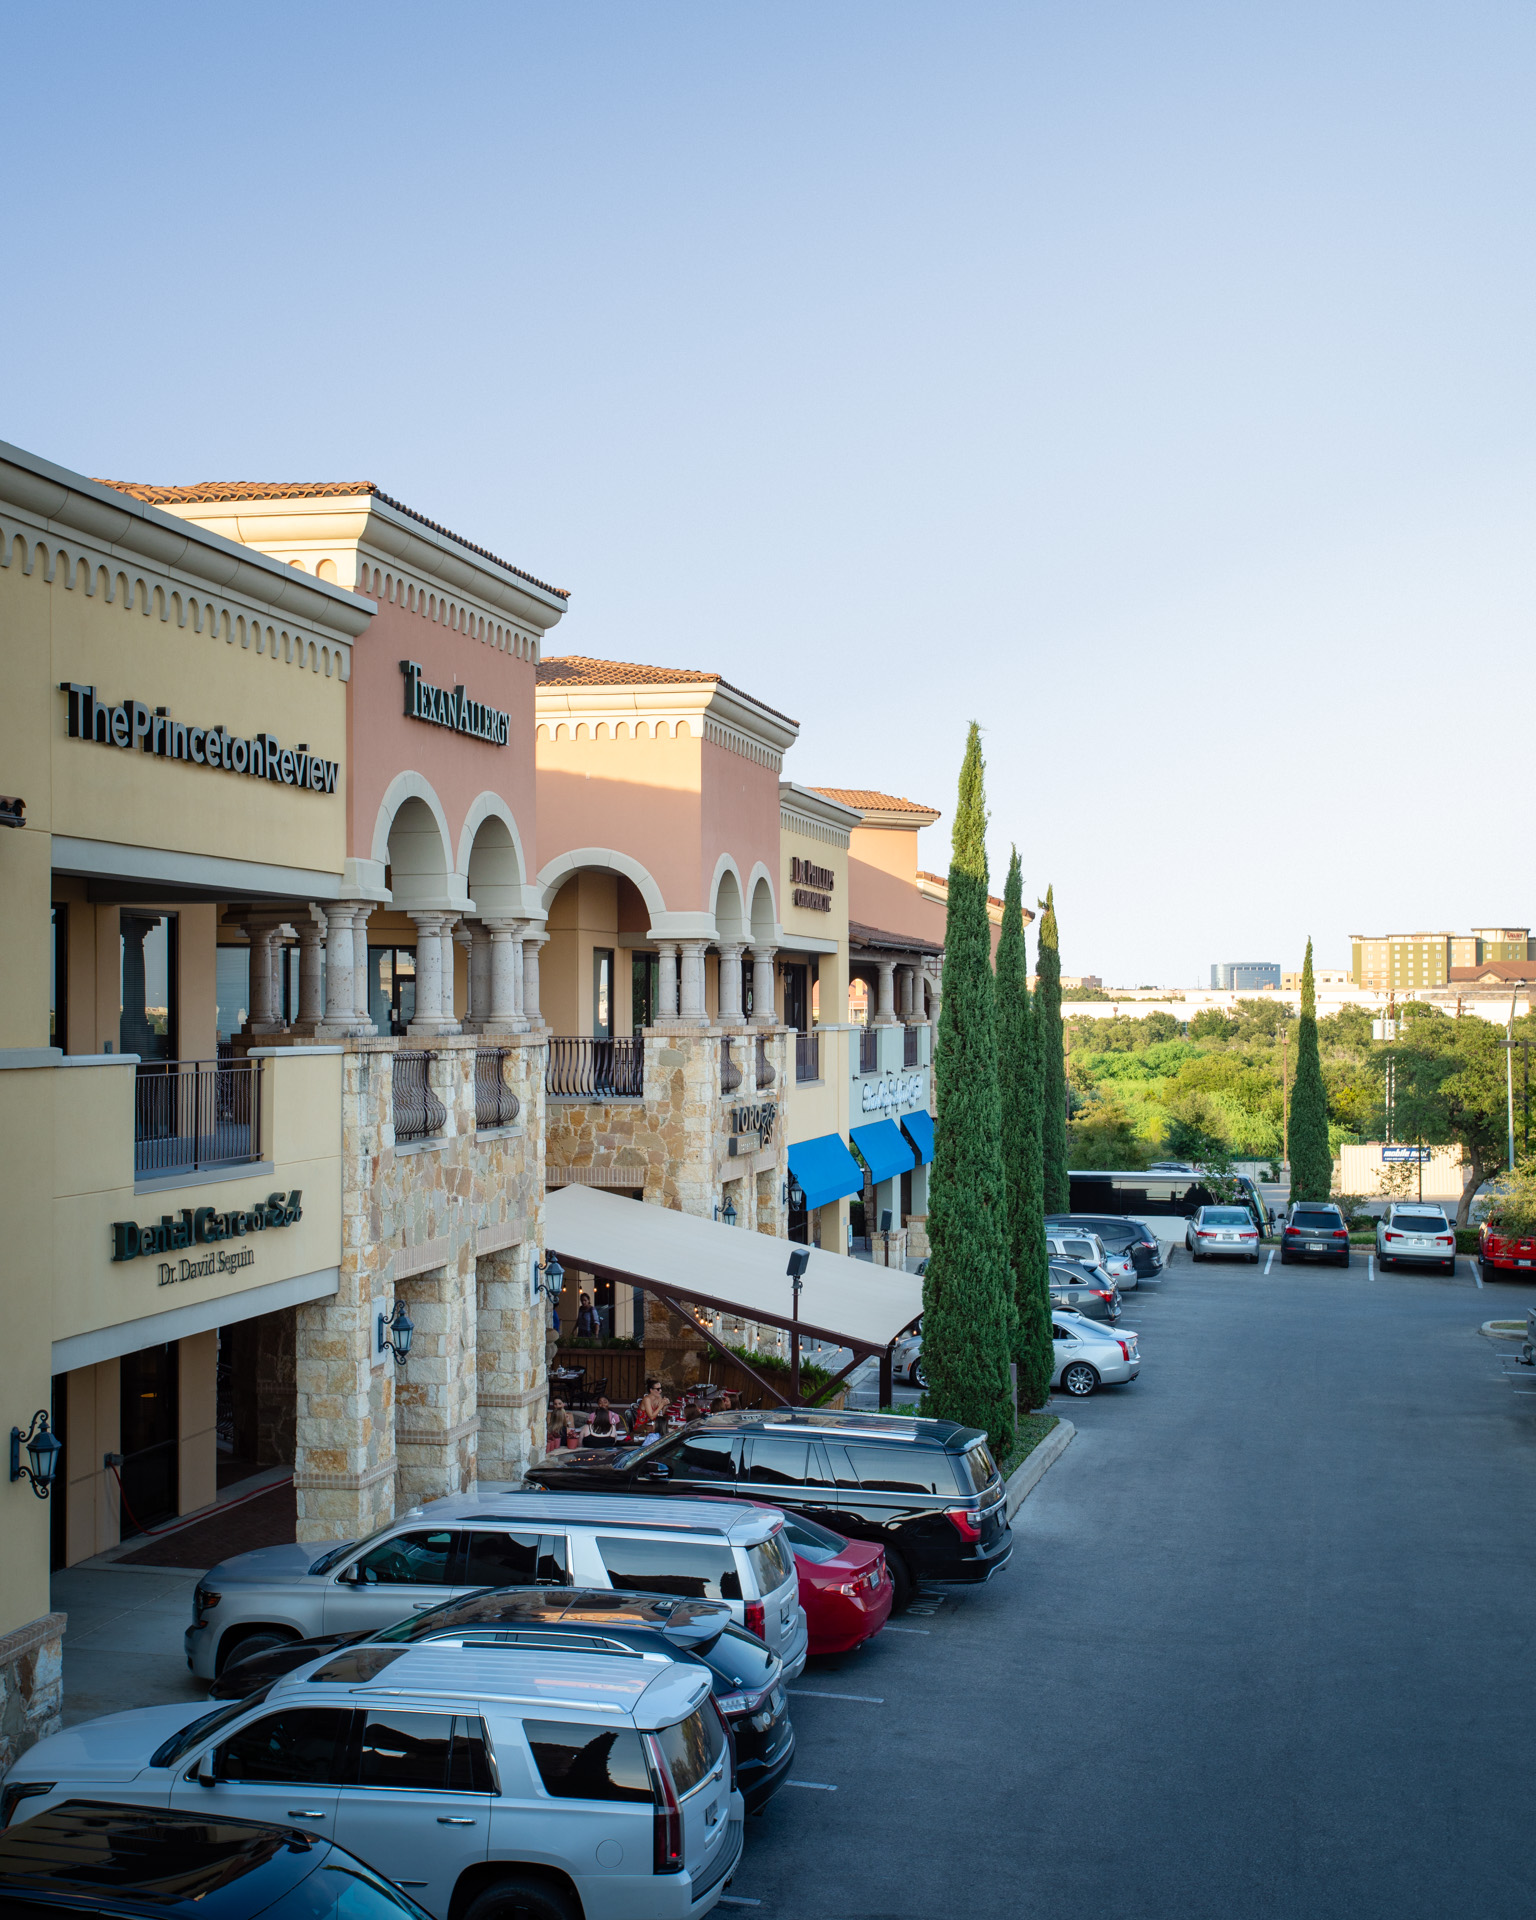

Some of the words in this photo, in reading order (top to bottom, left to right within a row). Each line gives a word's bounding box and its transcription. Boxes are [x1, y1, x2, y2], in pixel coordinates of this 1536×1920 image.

[60, 682, 130, 748] The
[124, 700, 263, 778] Princeton
[257, 733, 341, 794] Review
[455, 685, 511, 746] ALLERGY
[732, 1104, 761, 1133] TORO
[112, 1208, 196, 1261] Dental
[195, 1206, 248, 1244] Care
[250, 1203, 269, 1231] of
[158, 1263, 178, 1287] Dr.
[179, 1252, 216, 1282] David
[217, 1246, 256, 1275] Seguin
